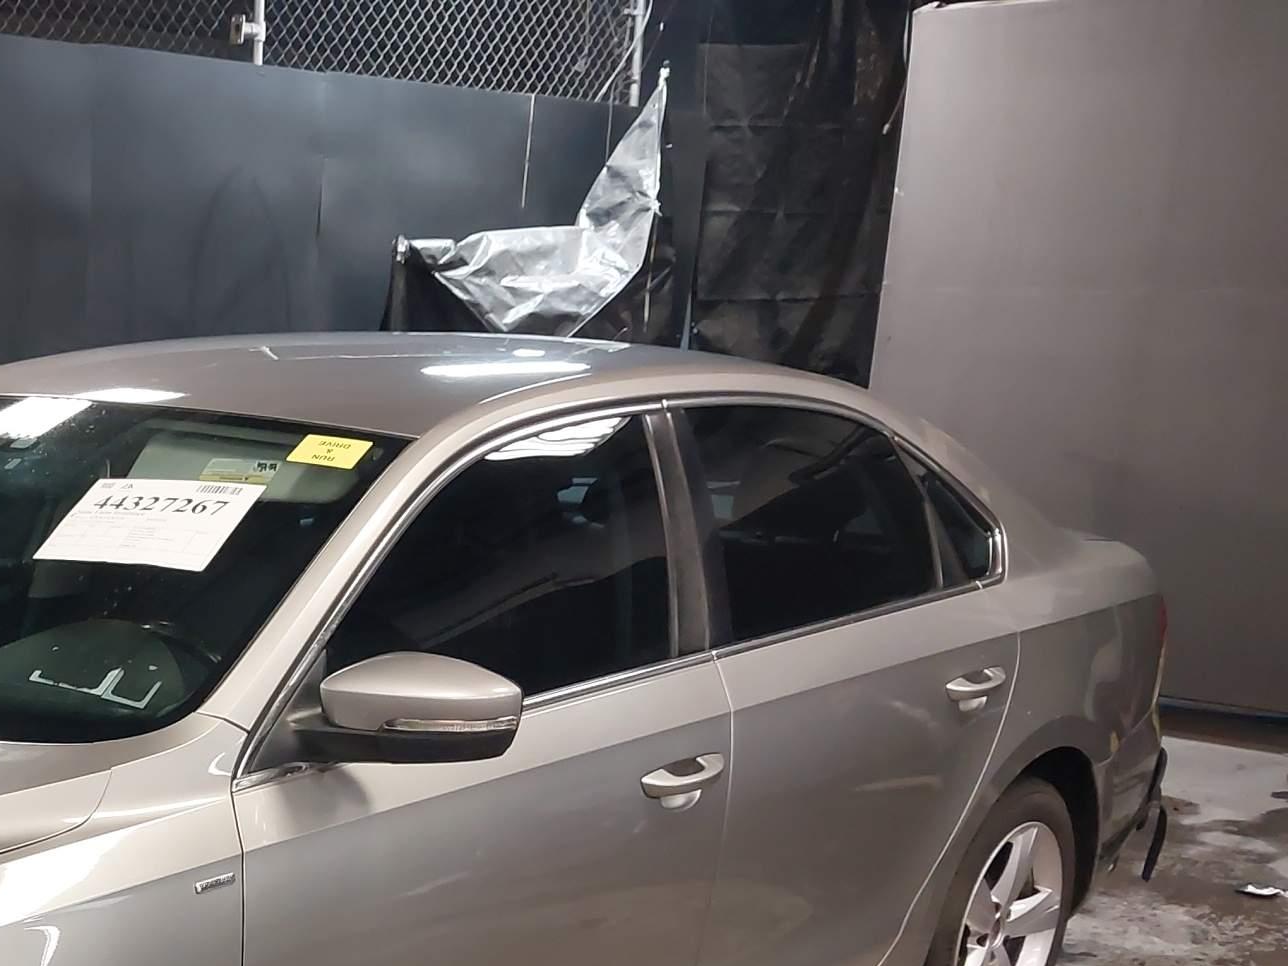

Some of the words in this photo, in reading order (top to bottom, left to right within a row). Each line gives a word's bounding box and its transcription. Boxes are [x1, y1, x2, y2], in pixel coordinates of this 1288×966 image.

[318, 440, 352, 449] DRIVE
[312, 454, 335, 462] RUN
[94, 495, 231, 515] 44327267
